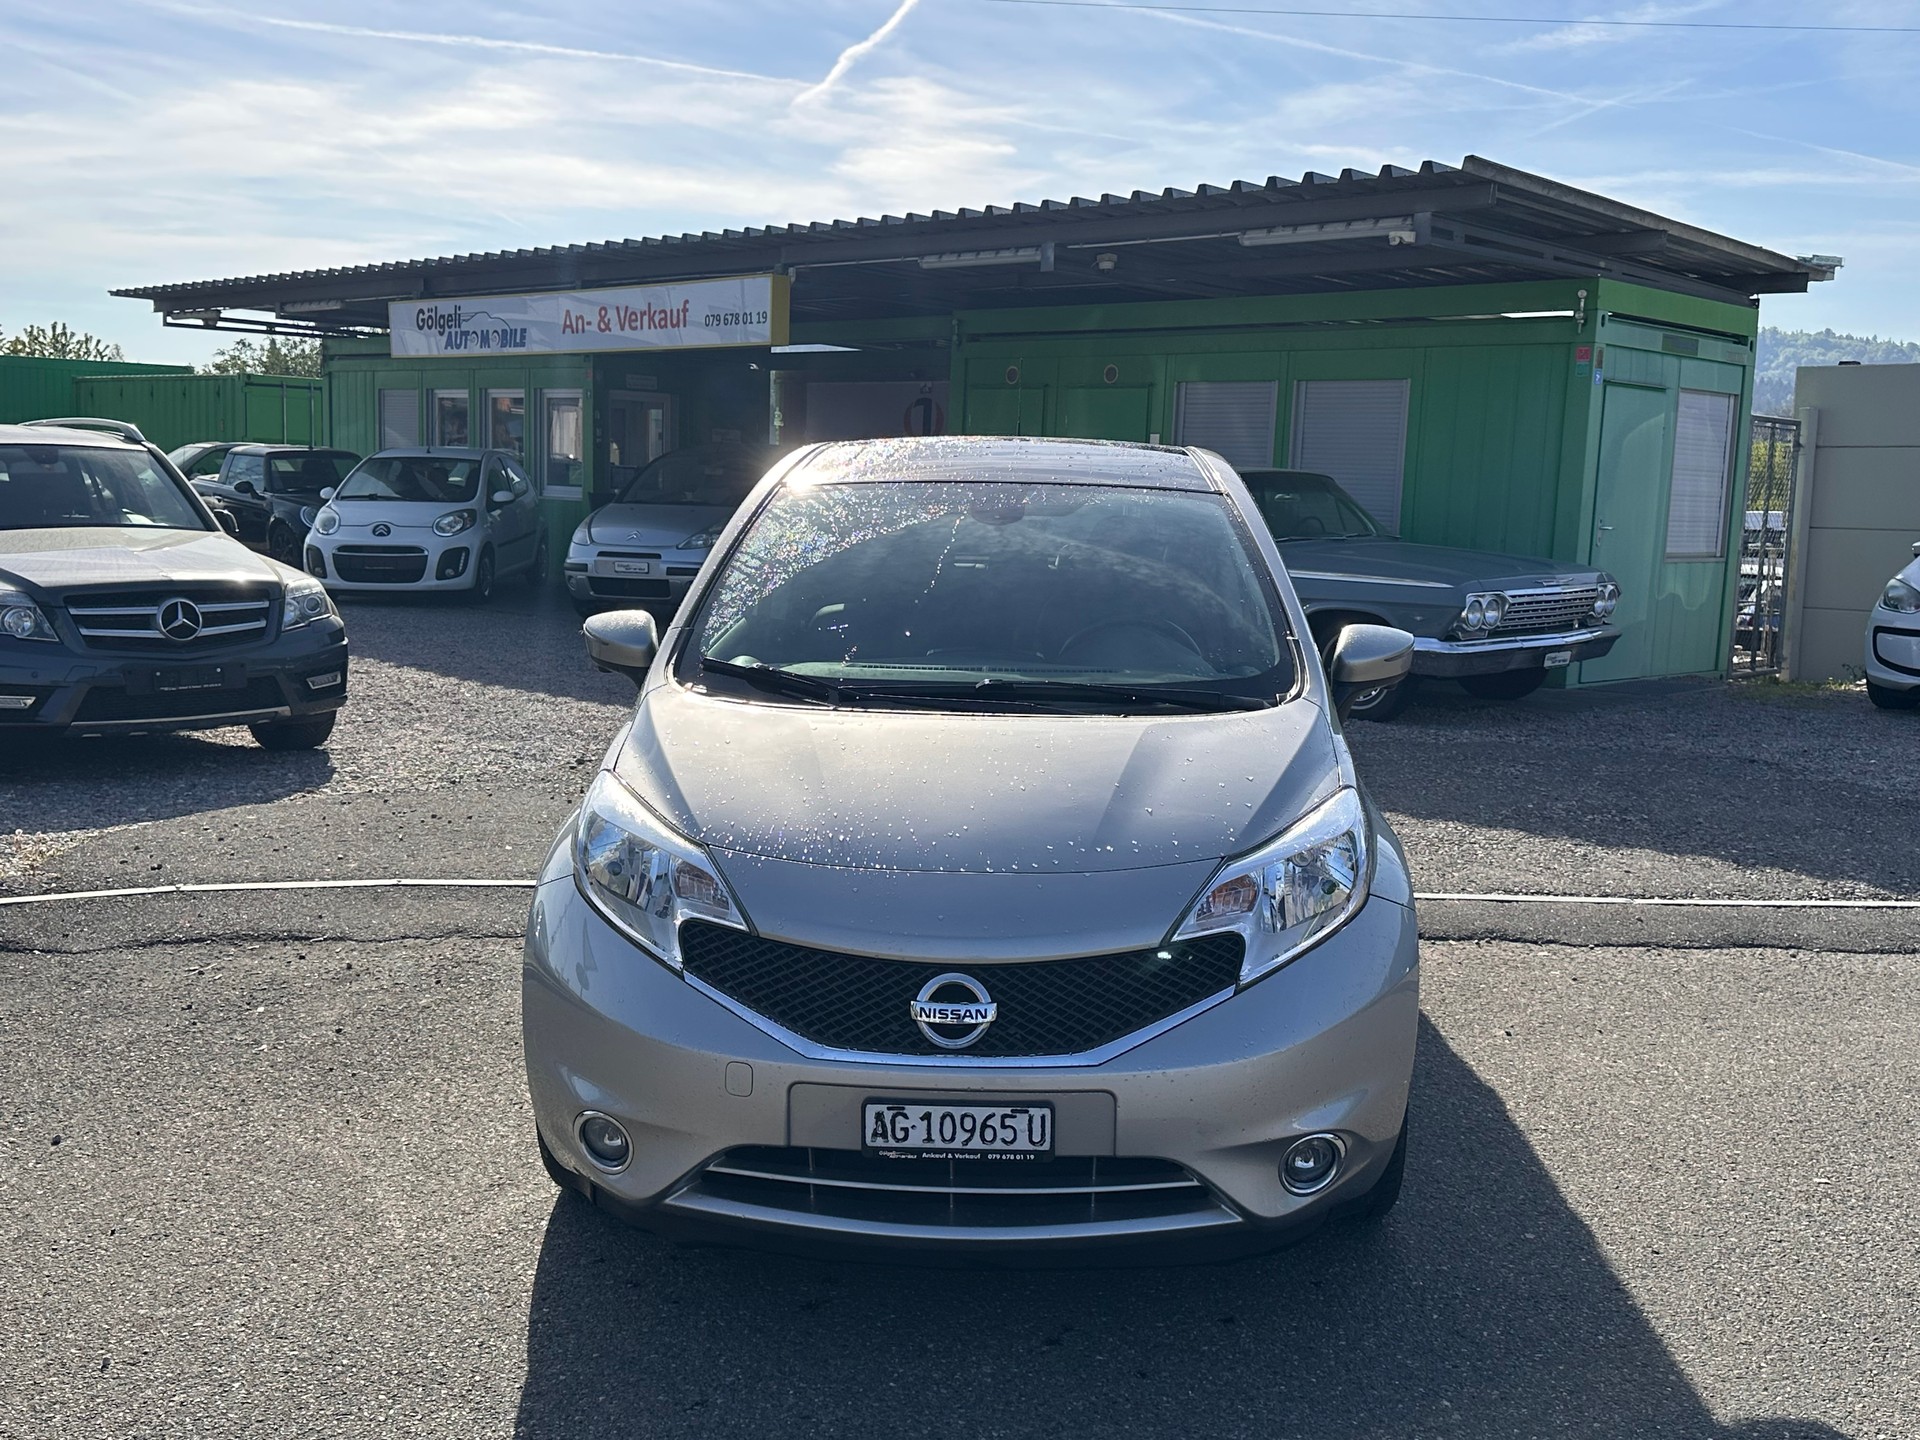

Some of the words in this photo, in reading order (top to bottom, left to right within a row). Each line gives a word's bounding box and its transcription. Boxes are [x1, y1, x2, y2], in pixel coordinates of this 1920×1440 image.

[416, 305, 461, 336] Gölgeli
[562, 309, 592, 334] An-
[597, 306, 612, 332] &
[615, 299, 689, 331] Verkauf
[704, 314, 721, 327] 079
[723, 313, 740, 325] 678
[742, 312, 753, 325] 01
[756, 311, 768, 324] 19
[444, 328, 527, 349] AUTOMOBILE
[919, 1006, 988, 1020] NISSAN
